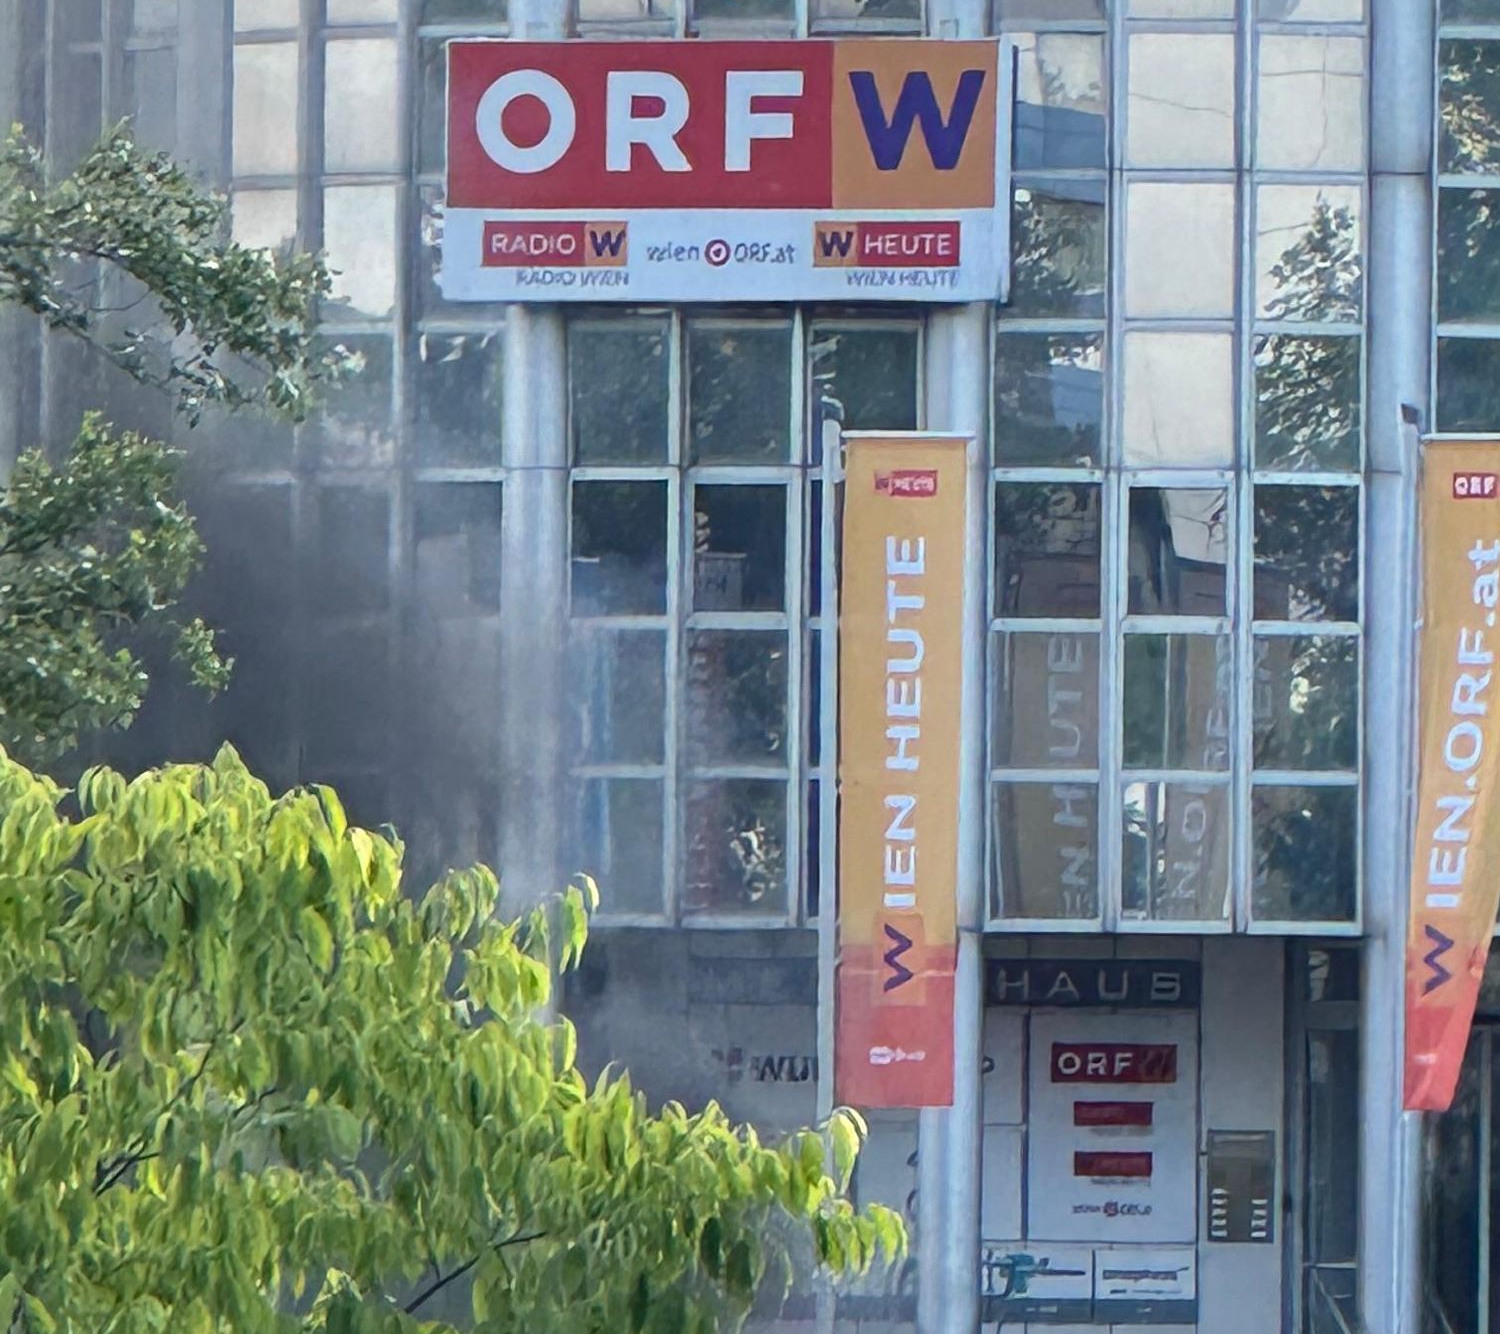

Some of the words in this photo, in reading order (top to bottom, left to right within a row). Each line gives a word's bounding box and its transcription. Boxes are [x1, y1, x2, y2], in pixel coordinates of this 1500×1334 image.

[476, 69, 804, 174] ORF
[848, 69, 986, 170] W
[491, 233, 577, 256] RADIO
[589, 229, 627, 257] W
[819, 230, 855, 257] W
[864, 233, 953, 256] HEUTE
[885, 535, 926, 773] HEUTE
[1057, 1051, 1135, 1076] ORF
